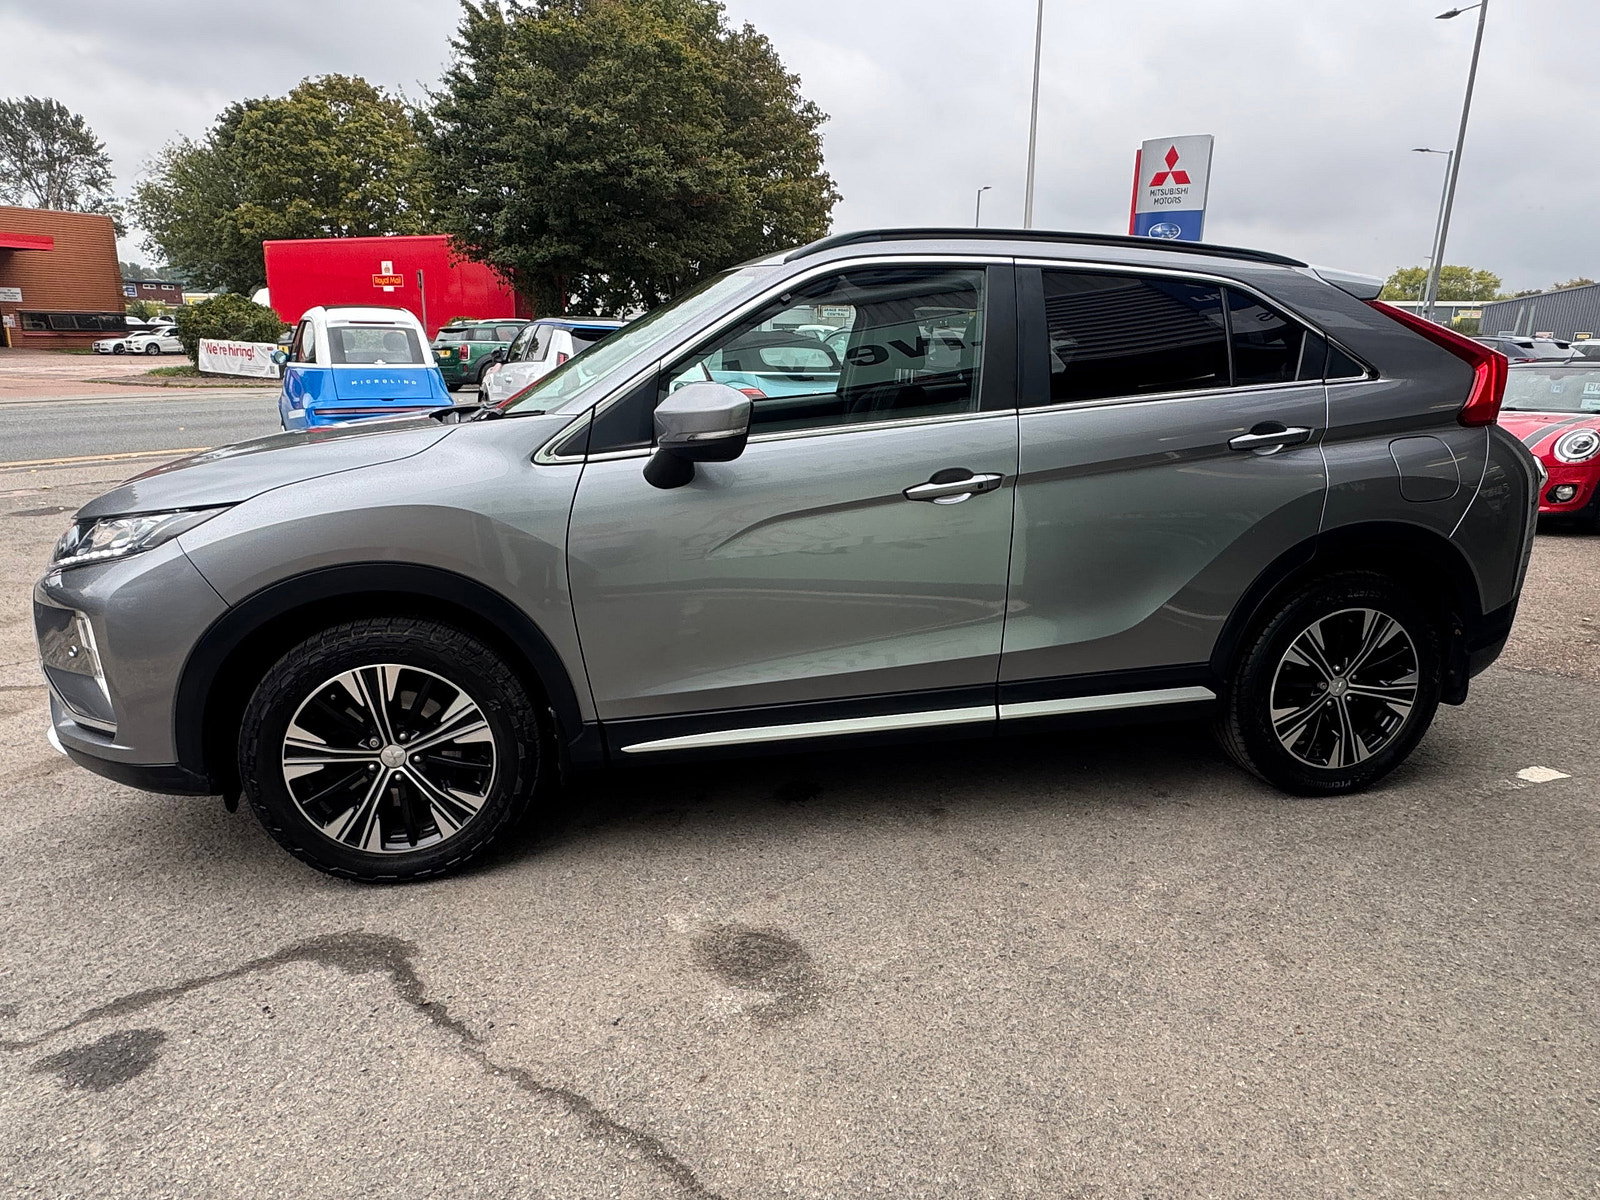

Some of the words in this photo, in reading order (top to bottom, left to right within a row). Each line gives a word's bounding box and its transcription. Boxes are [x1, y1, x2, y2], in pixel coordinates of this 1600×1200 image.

[1149, 187, 1189, 197] MITSUBISHI
[1153, 196, 1182, 205] MOTORS
[374, 276, 390, 285] Royal
[390, 276, 402, 284] Mail
[204, 342, 228, 355] We're
[227, 343, 255, 361] hiring!
